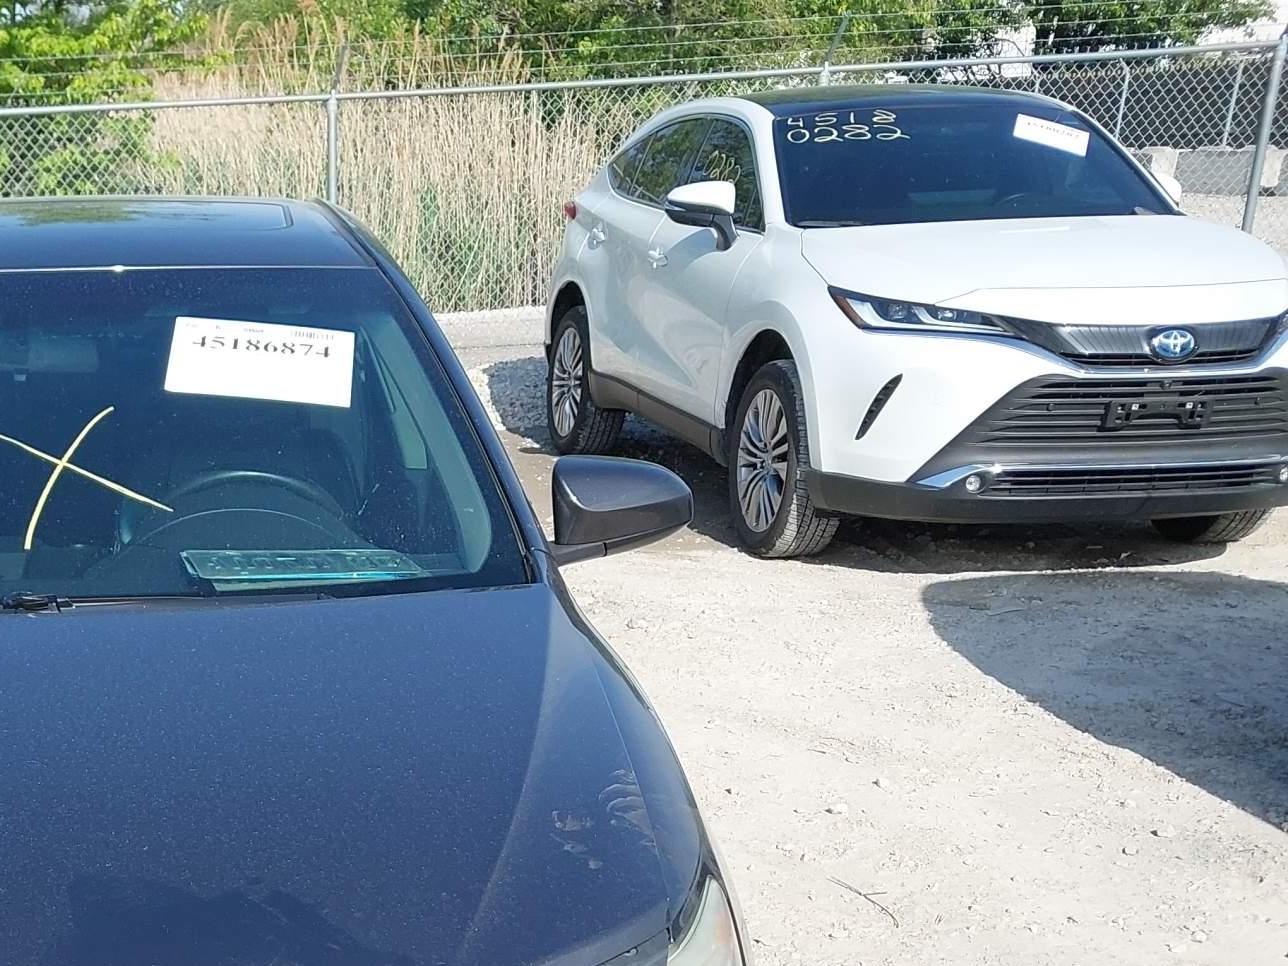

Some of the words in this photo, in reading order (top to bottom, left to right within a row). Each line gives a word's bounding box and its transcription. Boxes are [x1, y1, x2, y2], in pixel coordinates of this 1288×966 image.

[787, 109, 897, 127] 4518
[787, 123, 911, 144] 0282
[192, 335, 331, 358] 45186874
